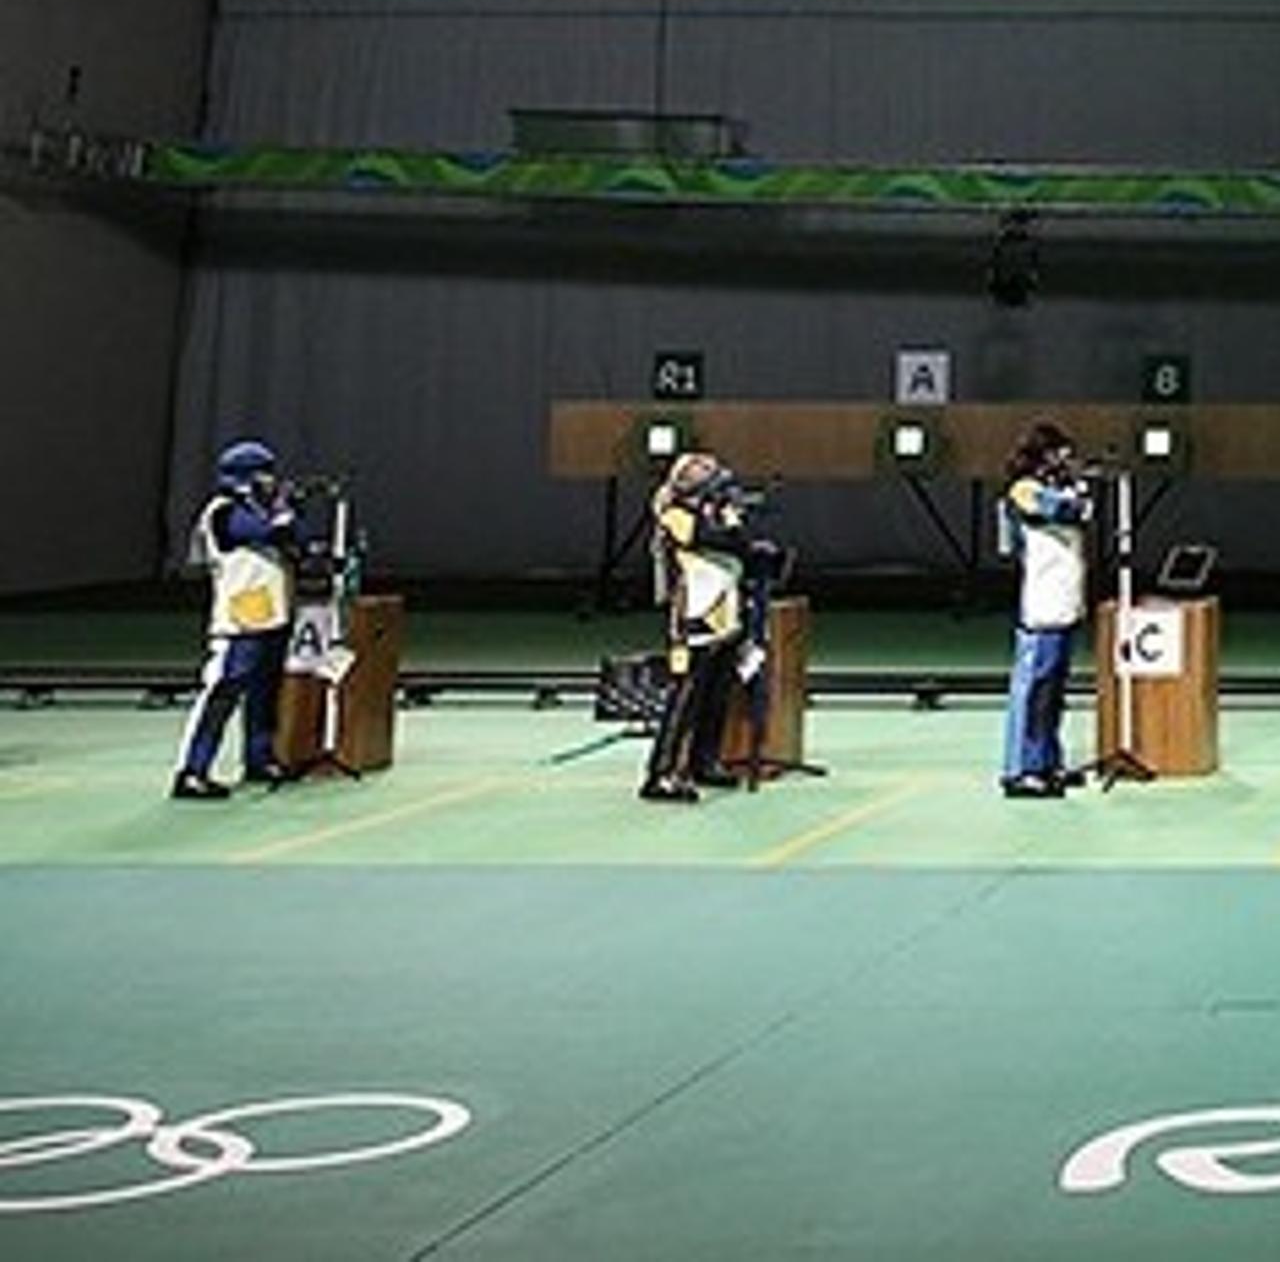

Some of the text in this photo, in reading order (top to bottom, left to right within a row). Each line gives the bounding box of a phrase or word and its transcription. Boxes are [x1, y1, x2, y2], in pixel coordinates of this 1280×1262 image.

[657, 359, 697, 393] R1
[910, 362, 936, 394] A
[294, 621, 323, 657] A
[1135, 621, 1164, 663] C
